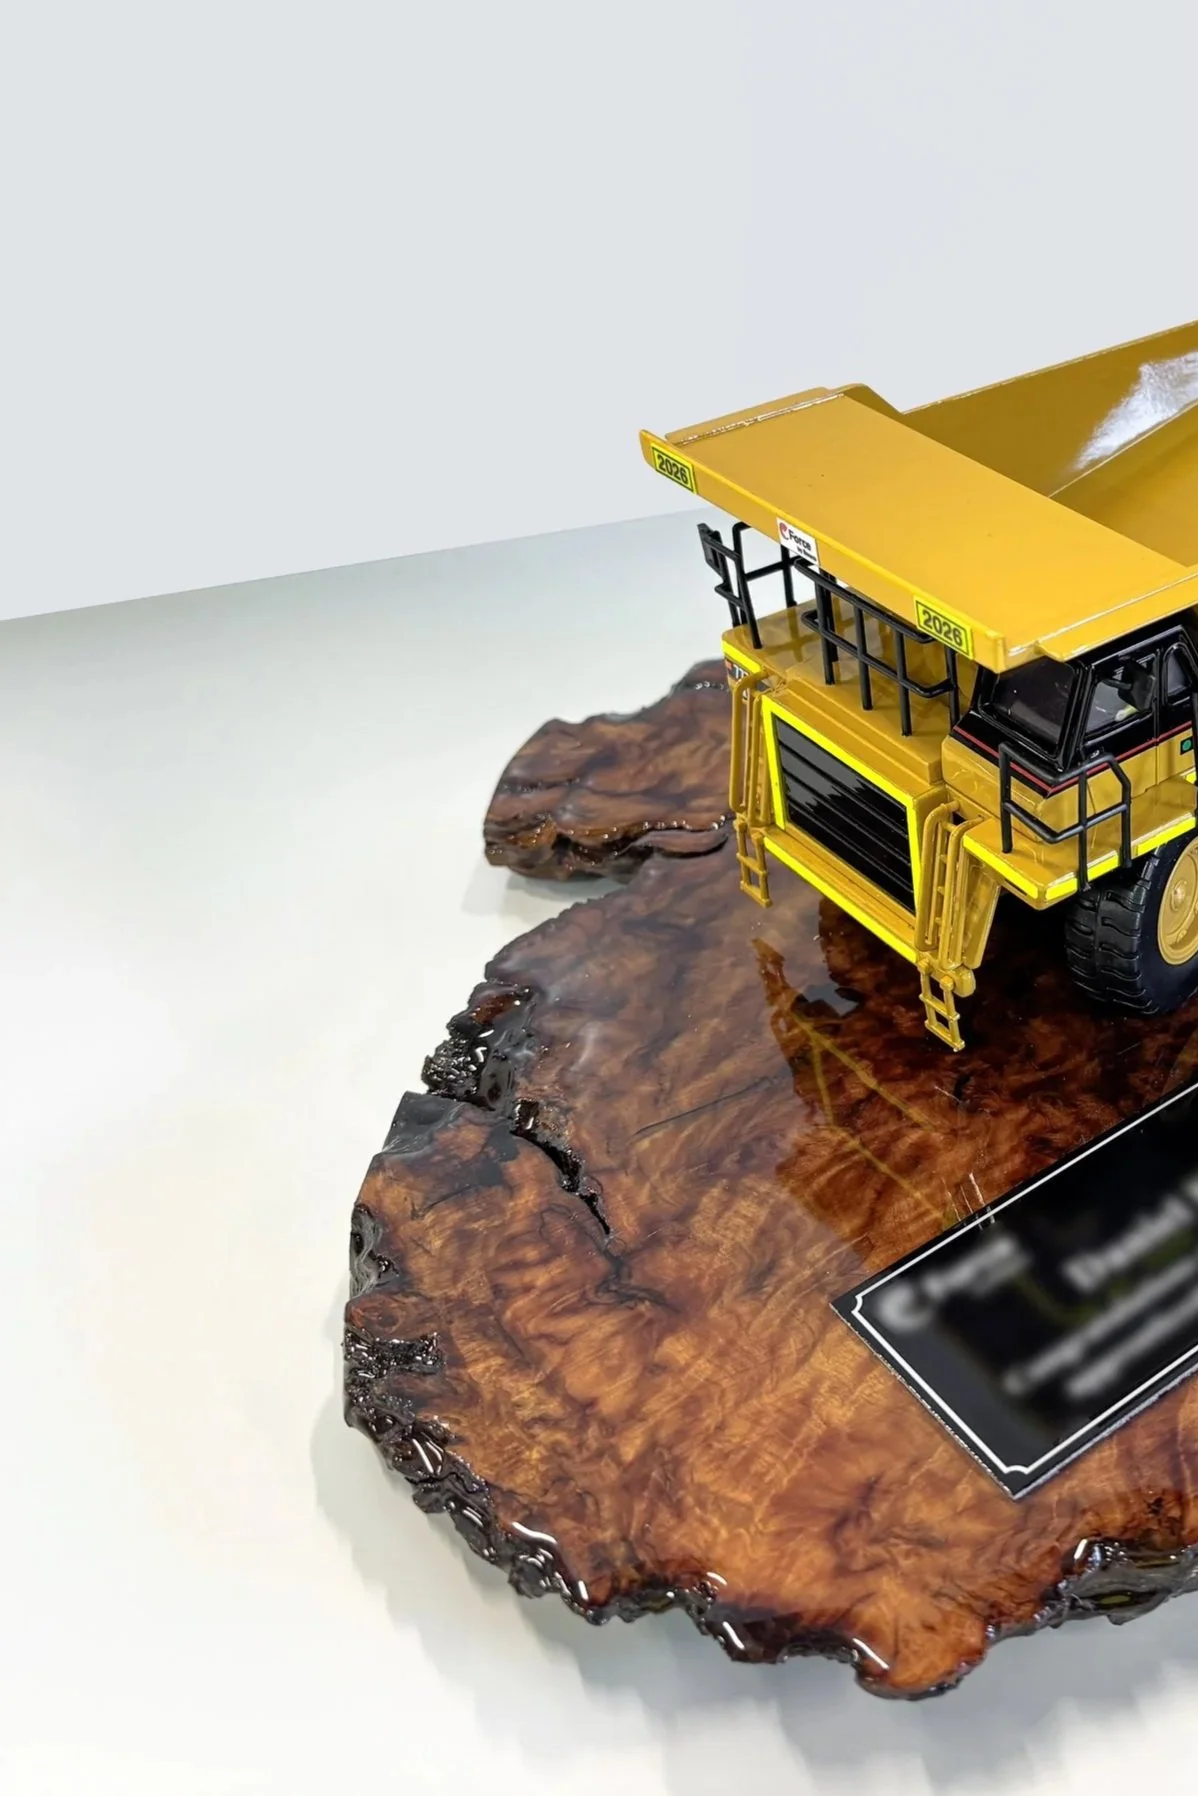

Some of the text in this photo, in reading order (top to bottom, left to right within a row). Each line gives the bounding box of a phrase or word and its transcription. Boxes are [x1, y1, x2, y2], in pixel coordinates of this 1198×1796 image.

[657, 453, 689, 485] 2026
[788, 529, 812, 551] Force
[922, 609, 963, 647] 2026
